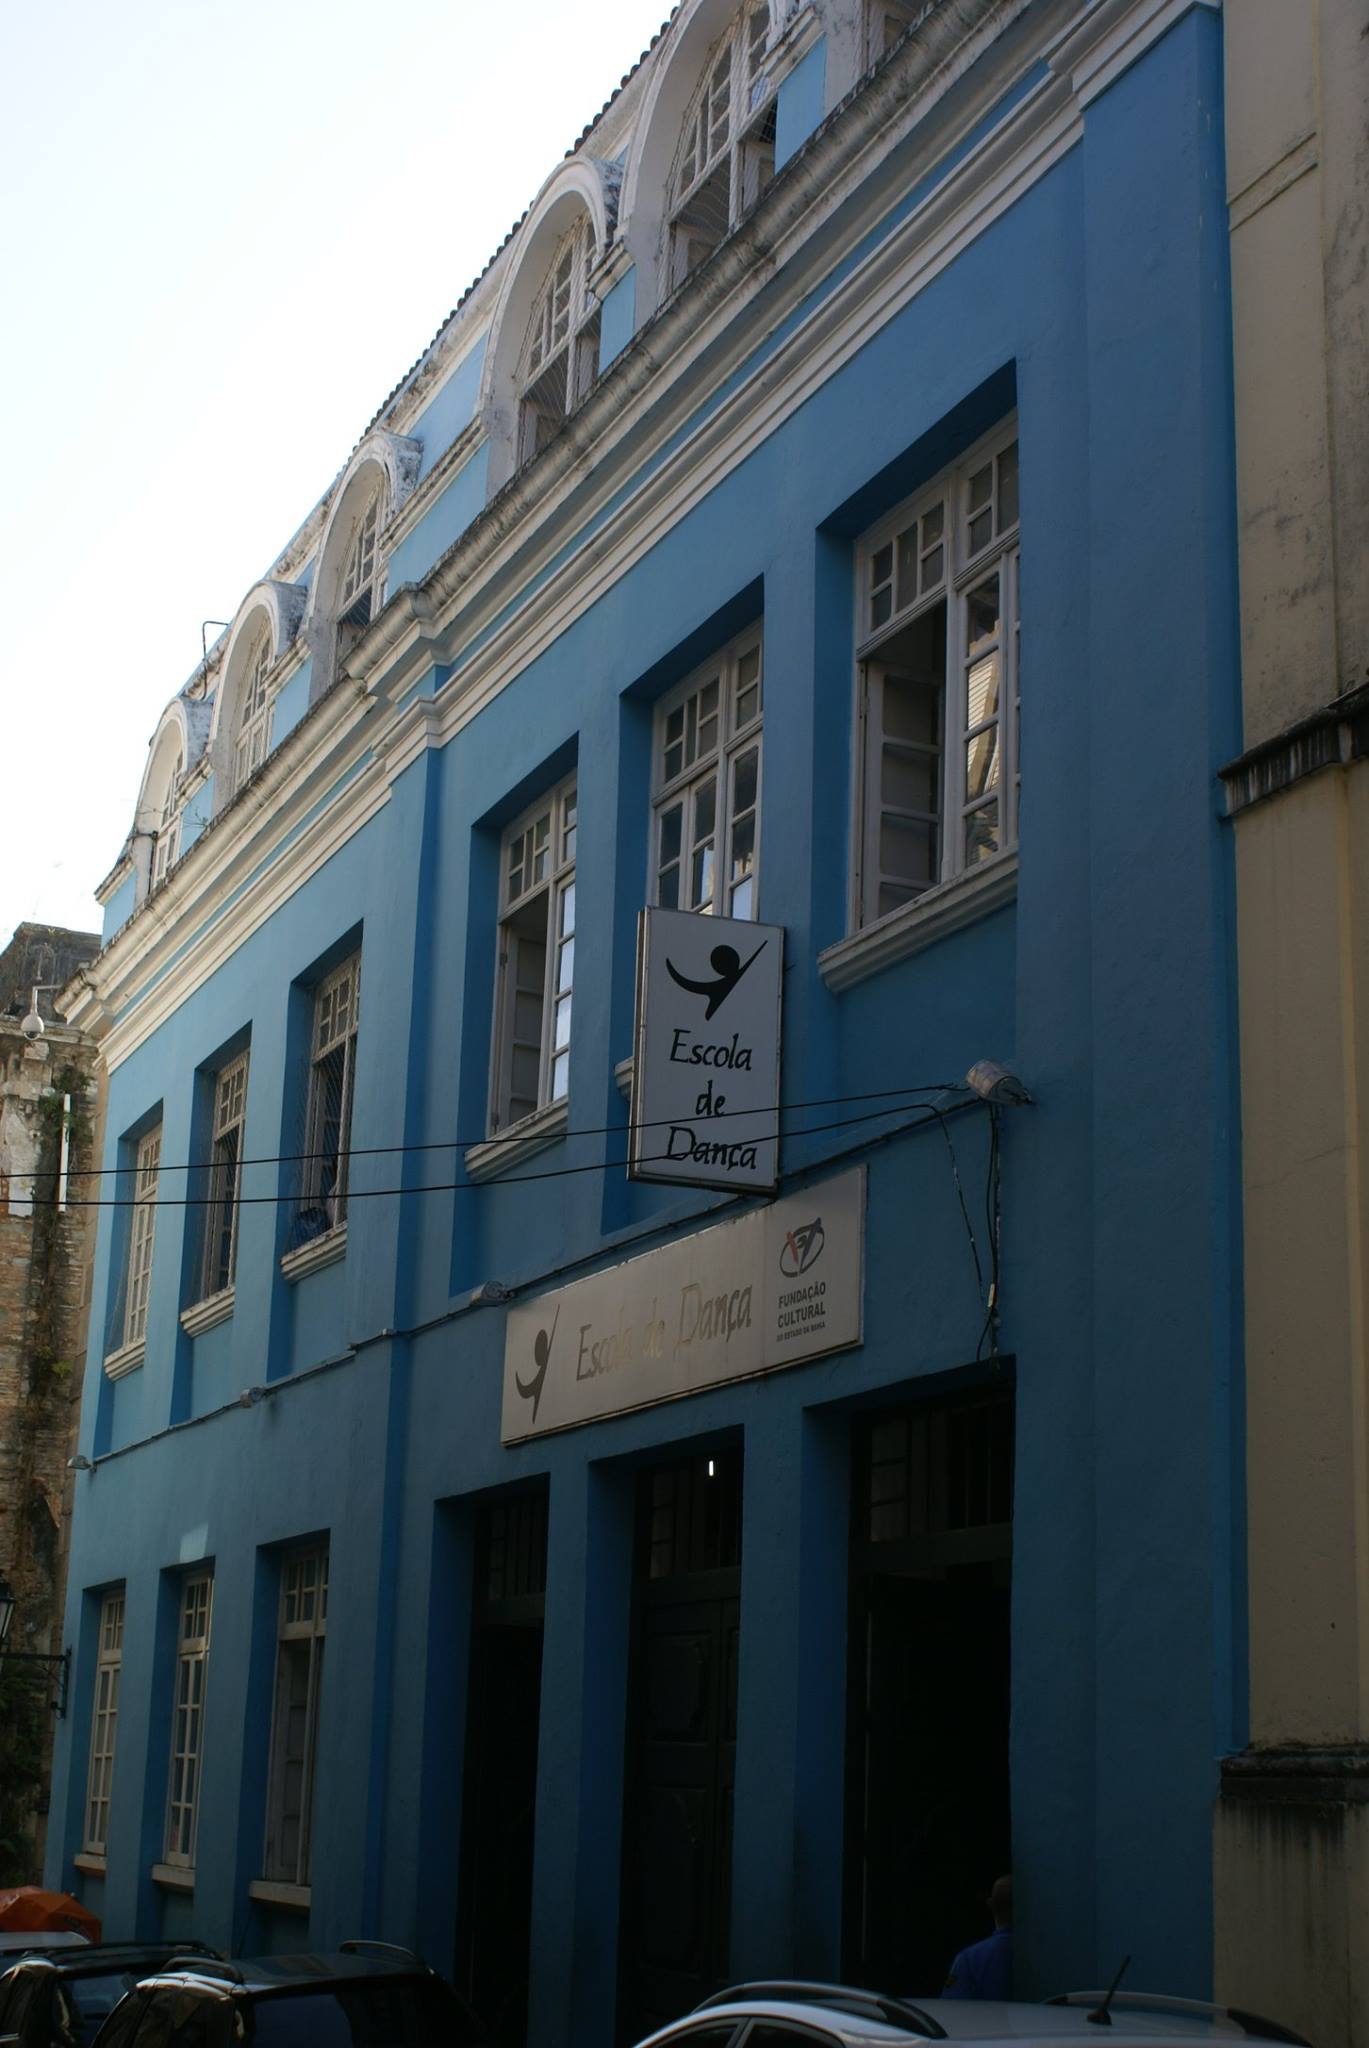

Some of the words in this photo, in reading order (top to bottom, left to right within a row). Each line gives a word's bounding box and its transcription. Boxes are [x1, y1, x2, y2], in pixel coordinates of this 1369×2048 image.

[670, 1028, 752, 1072] Escola
[695, 1080, 726, 1117] de
[665, 1126, 757, 1171] Dança
[777, 1301, 826, 1329] CULTURAL
[778, 1281, 826, 1309] FUNDAÇÃO
[576, 1305, 633, 1382] Escola
[642, 1297, 666, 1358] de
[675, 1283, 753, 1354] Dança
